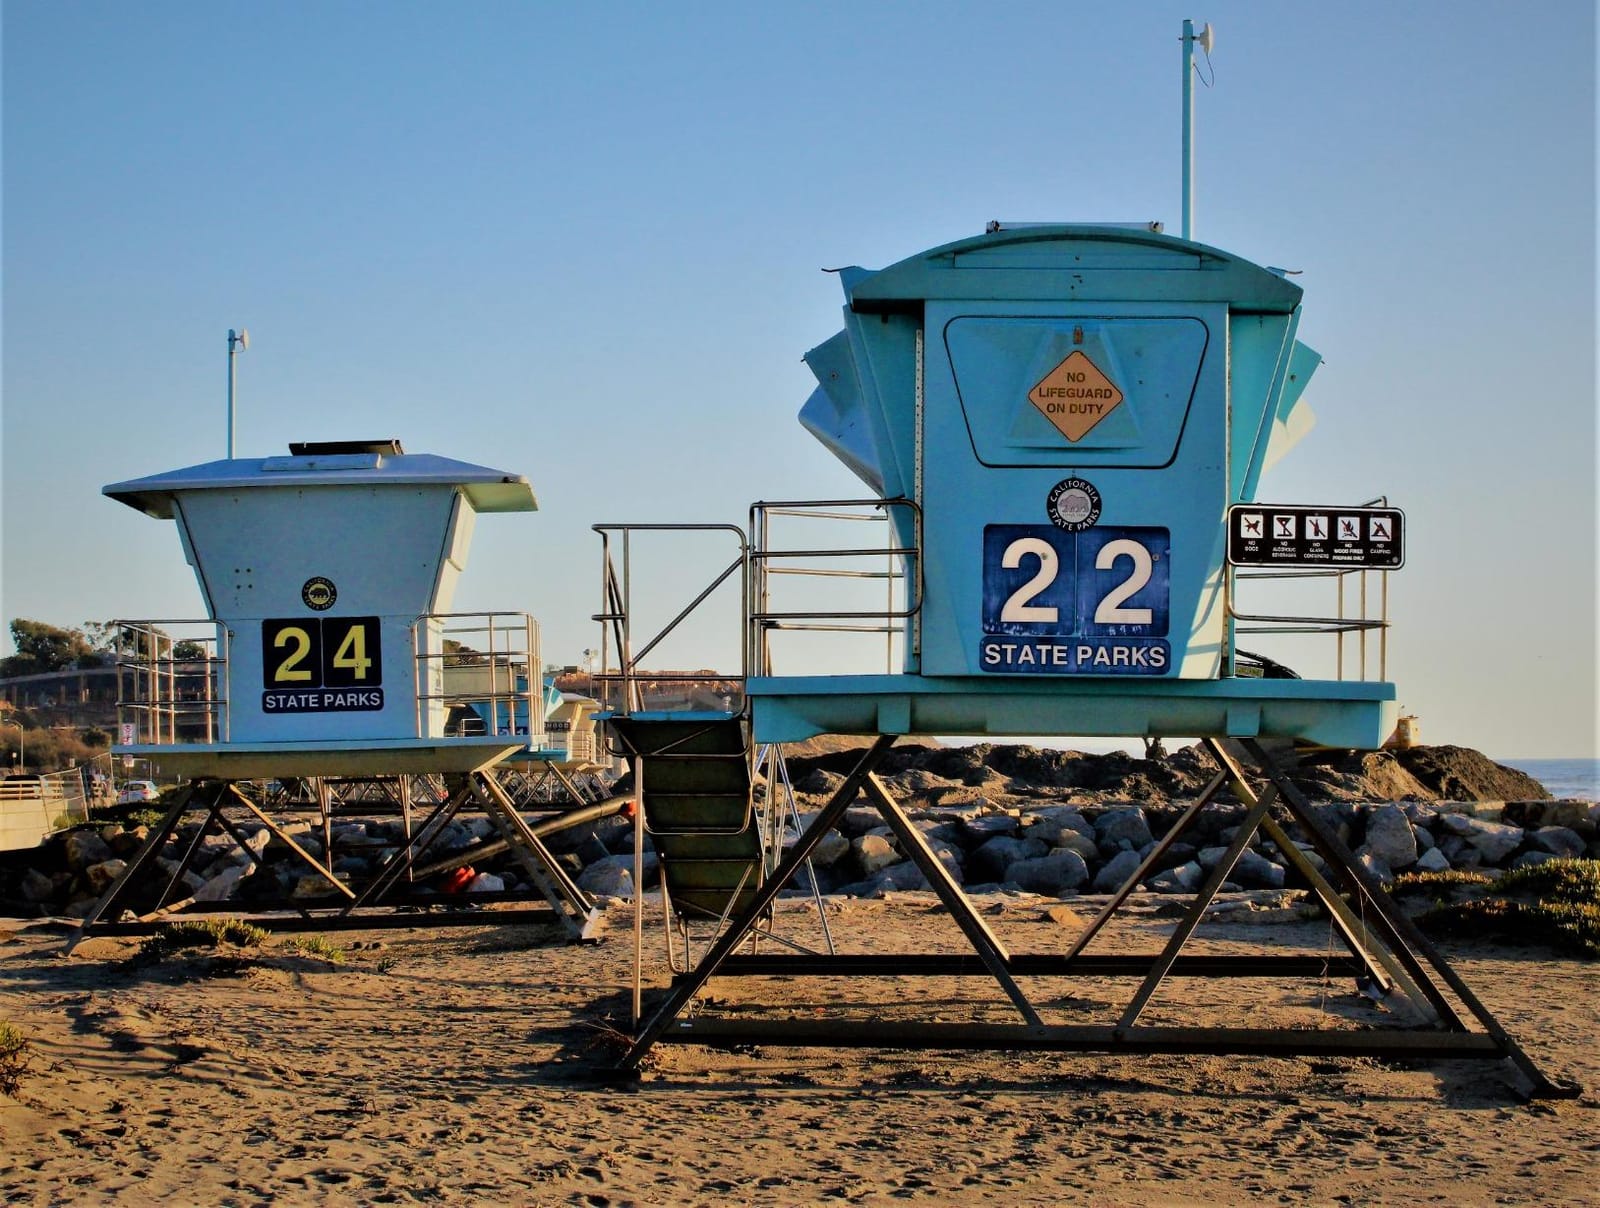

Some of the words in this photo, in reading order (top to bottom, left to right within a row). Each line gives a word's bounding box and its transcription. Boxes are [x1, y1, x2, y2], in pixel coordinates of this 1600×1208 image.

[1066, 372, 1086, 383] NO
[1038, 387, 1113, 399] LIFEGUARD
[1046, 402, 1065, 414] ON
[1069, 403, 1104, 414] DUTY
[1050, 480, 1099, 504] CALIFORNIA
[1049, 508, 1073, 531] STATE
[1077, 508, 1100, 531] PARKS
[1000, 537, 1153, 625] 22
[273, 625, 372, 682] 24
[984, 643, 1068, 666] STATE
[1076, 645, 1166, 668] PARKS
[265, 694, 319, 709] STATE
[324, 692, 381, 707] PARKS
